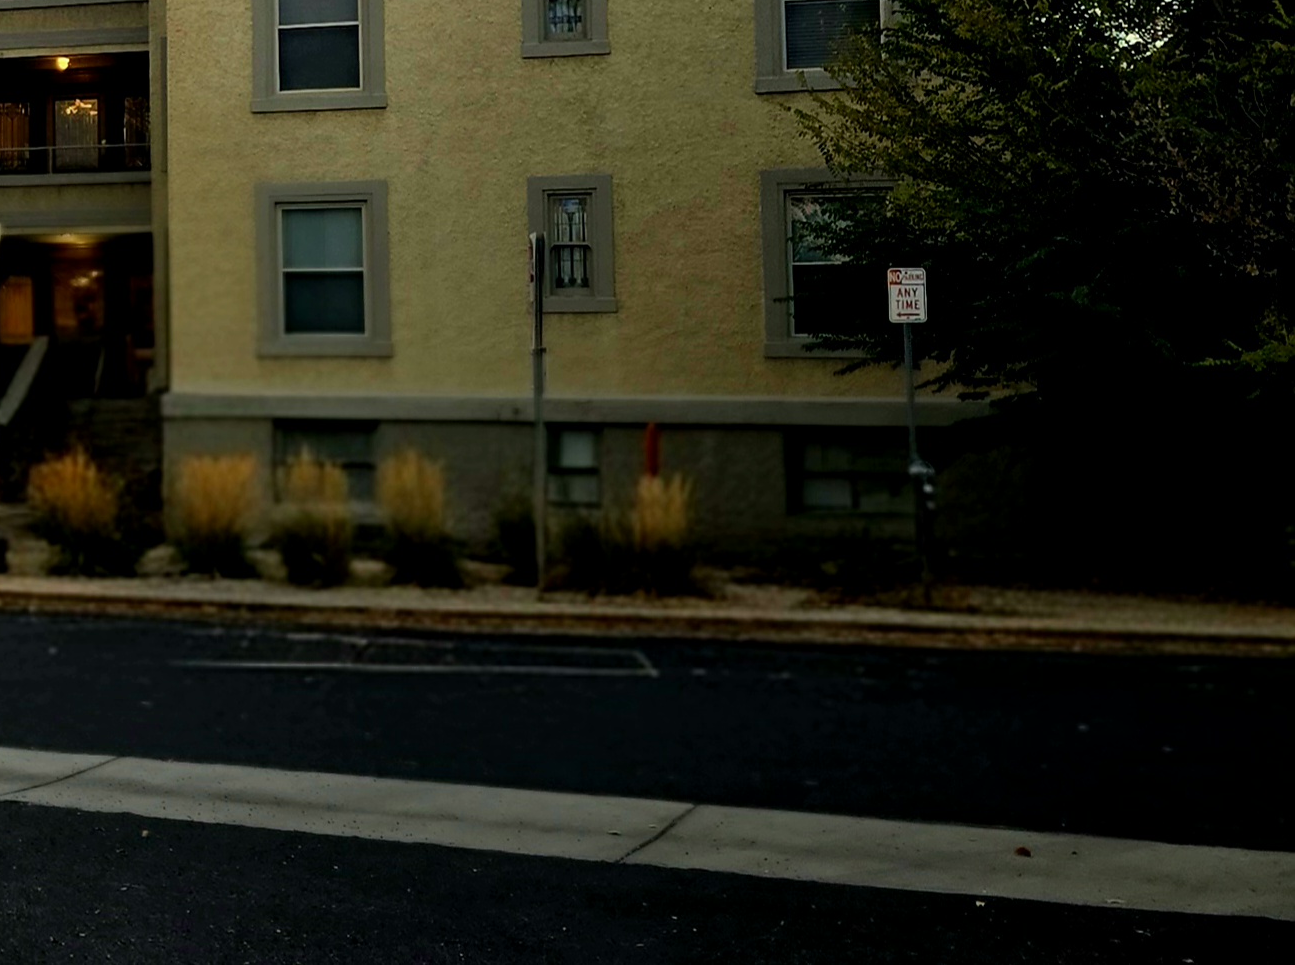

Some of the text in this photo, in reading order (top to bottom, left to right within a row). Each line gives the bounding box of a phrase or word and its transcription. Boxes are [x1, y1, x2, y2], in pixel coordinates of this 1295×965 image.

[890, 271, 902, 283] NO
[897, 287, 918, 298] ANY
[896, 300, 920, 310] TIME
